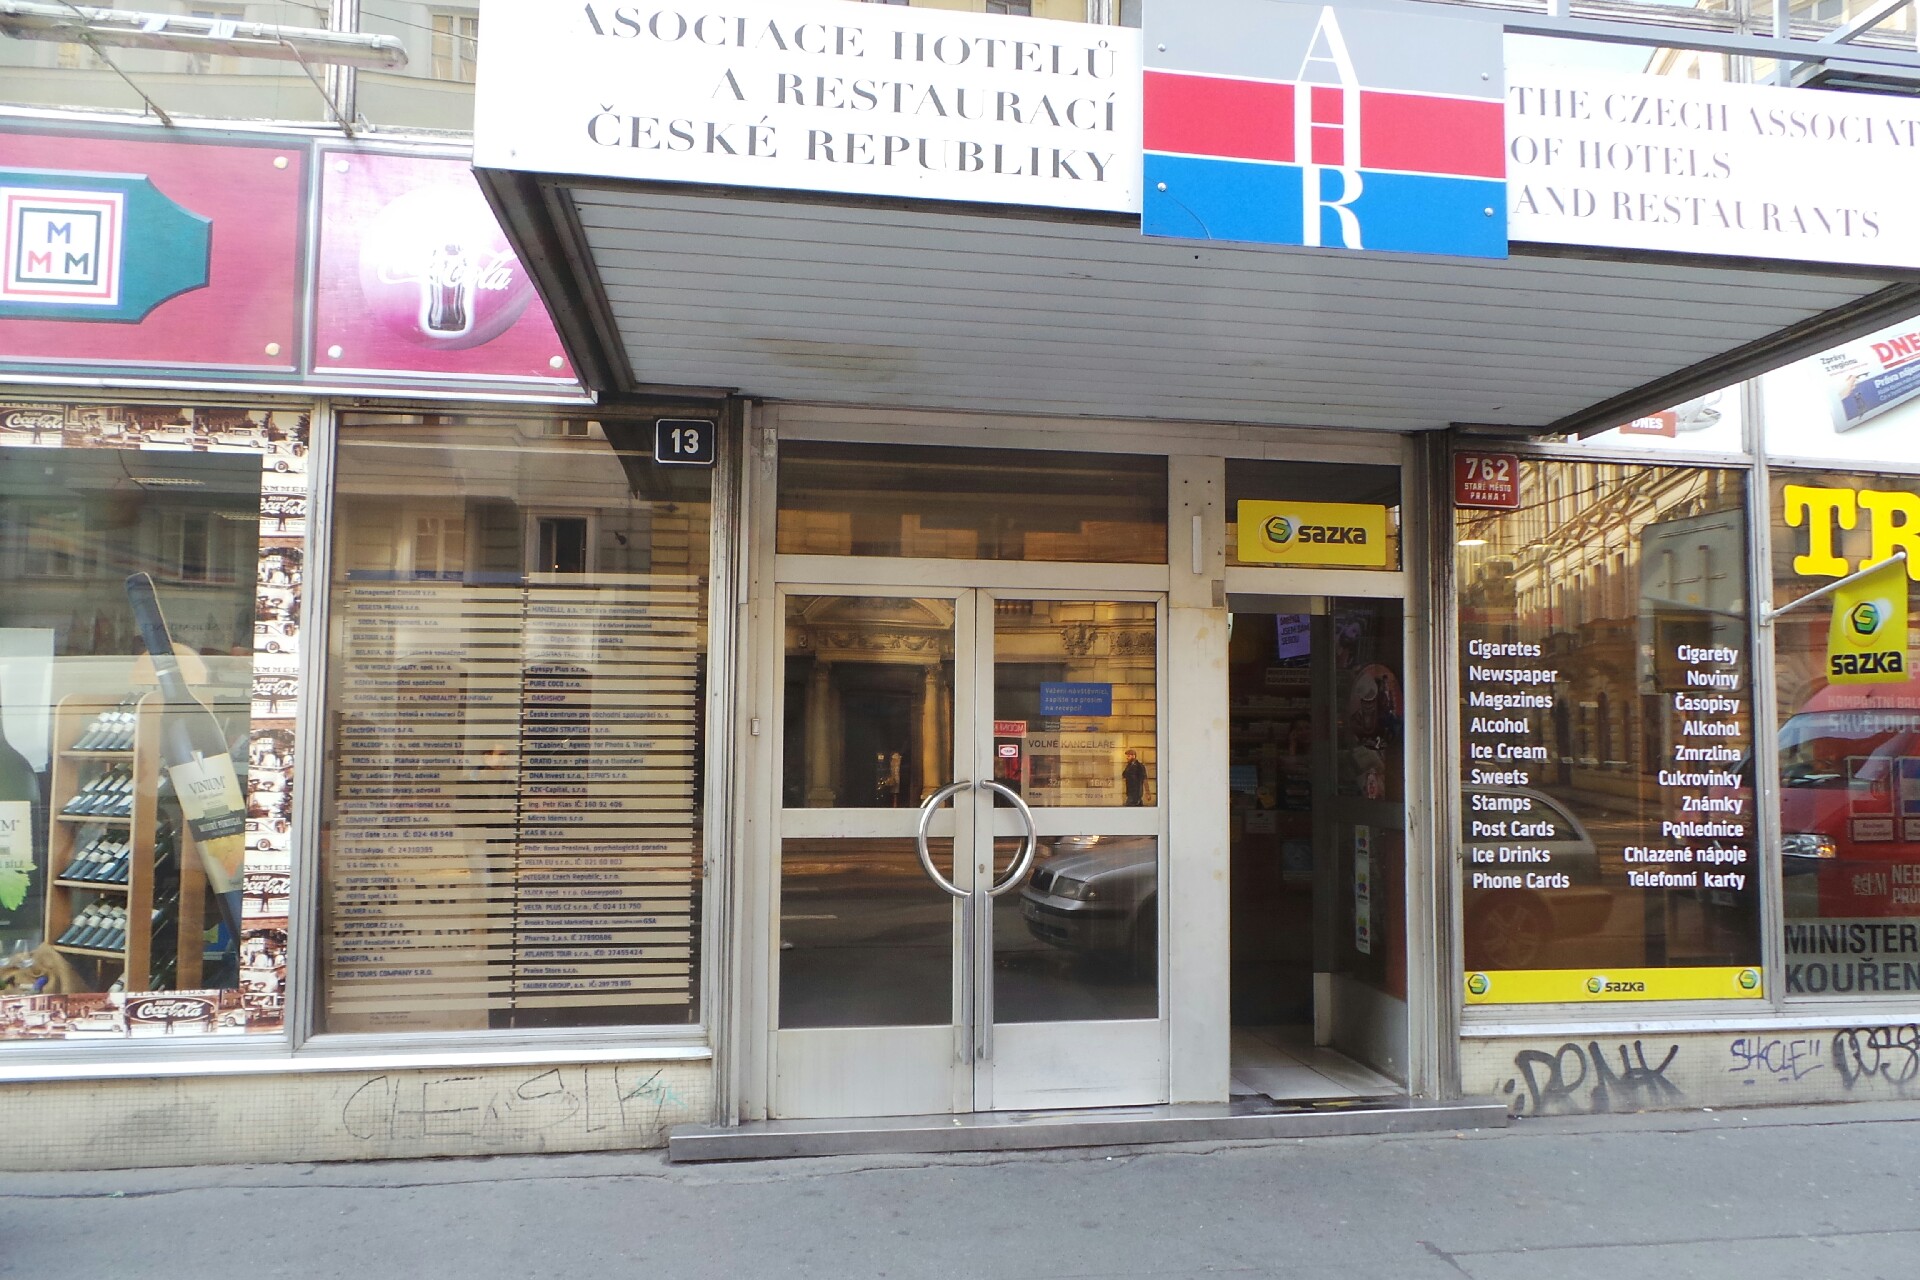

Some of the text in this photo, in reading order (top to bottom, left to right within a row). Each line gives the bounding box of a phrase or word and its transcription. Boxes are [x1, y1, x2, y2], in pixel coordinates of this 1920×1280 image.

[570, 2, 1118, 80] ASOCIACE HOTELŮ
[712, 68, 1117, 132] A RESTAURACÍ
[1509, 86, 1591, 121] THE
[1604, 93, 1728, 132] CZECH
[587, 104, 1118, 183] ČESKÉ REPUBLIKY
[1510, 135, 1731, 179] OF HOTELS
[1513, 185, 1880, 239] AND RESTAURANTS
[47, 221, 72, 244] M
[28, 249, 90, 276] M M
[1820, 354, 1846, 365] Zprávy
[1631, 416, 1664, 430] DNES
[671, 428, 699, 454] 13
[1465, 457, 1510, 482] 762
[1464, 482, 1512, 492] STARÉ MĚSTO
[1470, 492, 1506, 501] PRAHA 1
[1298, 525, 1367, 545] sazka
[1469, 639, 1541, 660] Cigaretes
[1677, 645, 1738, 665] Cigarety
[1831, 651, 1903, 675] sazka
[1469, 665, 1558, 685] Newspaper
[1687, 670, 1739, 690] Noviny
[1469, 691, 1553, 711] Magazines
[1675, 692, 1740, 714] Časopisy
[1470, 717, 1529, 733] Alcohol
[1683, 720, 1740, 736] Alkohol
[1028, 738, 1059, 748] VOLNÉ
[1471, 743, 1547, 759] Ice Cream
[1675, 745, 1741, 761] Zmrzlina
[1471, 769, 1529, 785] Sweets
[1658, 770, 1742, 789] Cukrovinky
[1472, 794, 1531, 813] Stamps
[1682, 795, 1743, 815] Známky
[1472, 821, 1555, 837] Post Cards
[1662, 821, 1744, 837] Pohlednice
[1472, 847, 1550, 863] Ice Drinks
[1624, 847, 1746, 865] Chlazené nápoje
[1472, 873, 1570, 889] Phone Cards
[1627, 871, 1745, 891] Telefonní karty
[1784, 923, 1920, 955] MINISTER
[1604, 980, 1645, 992] sazka
